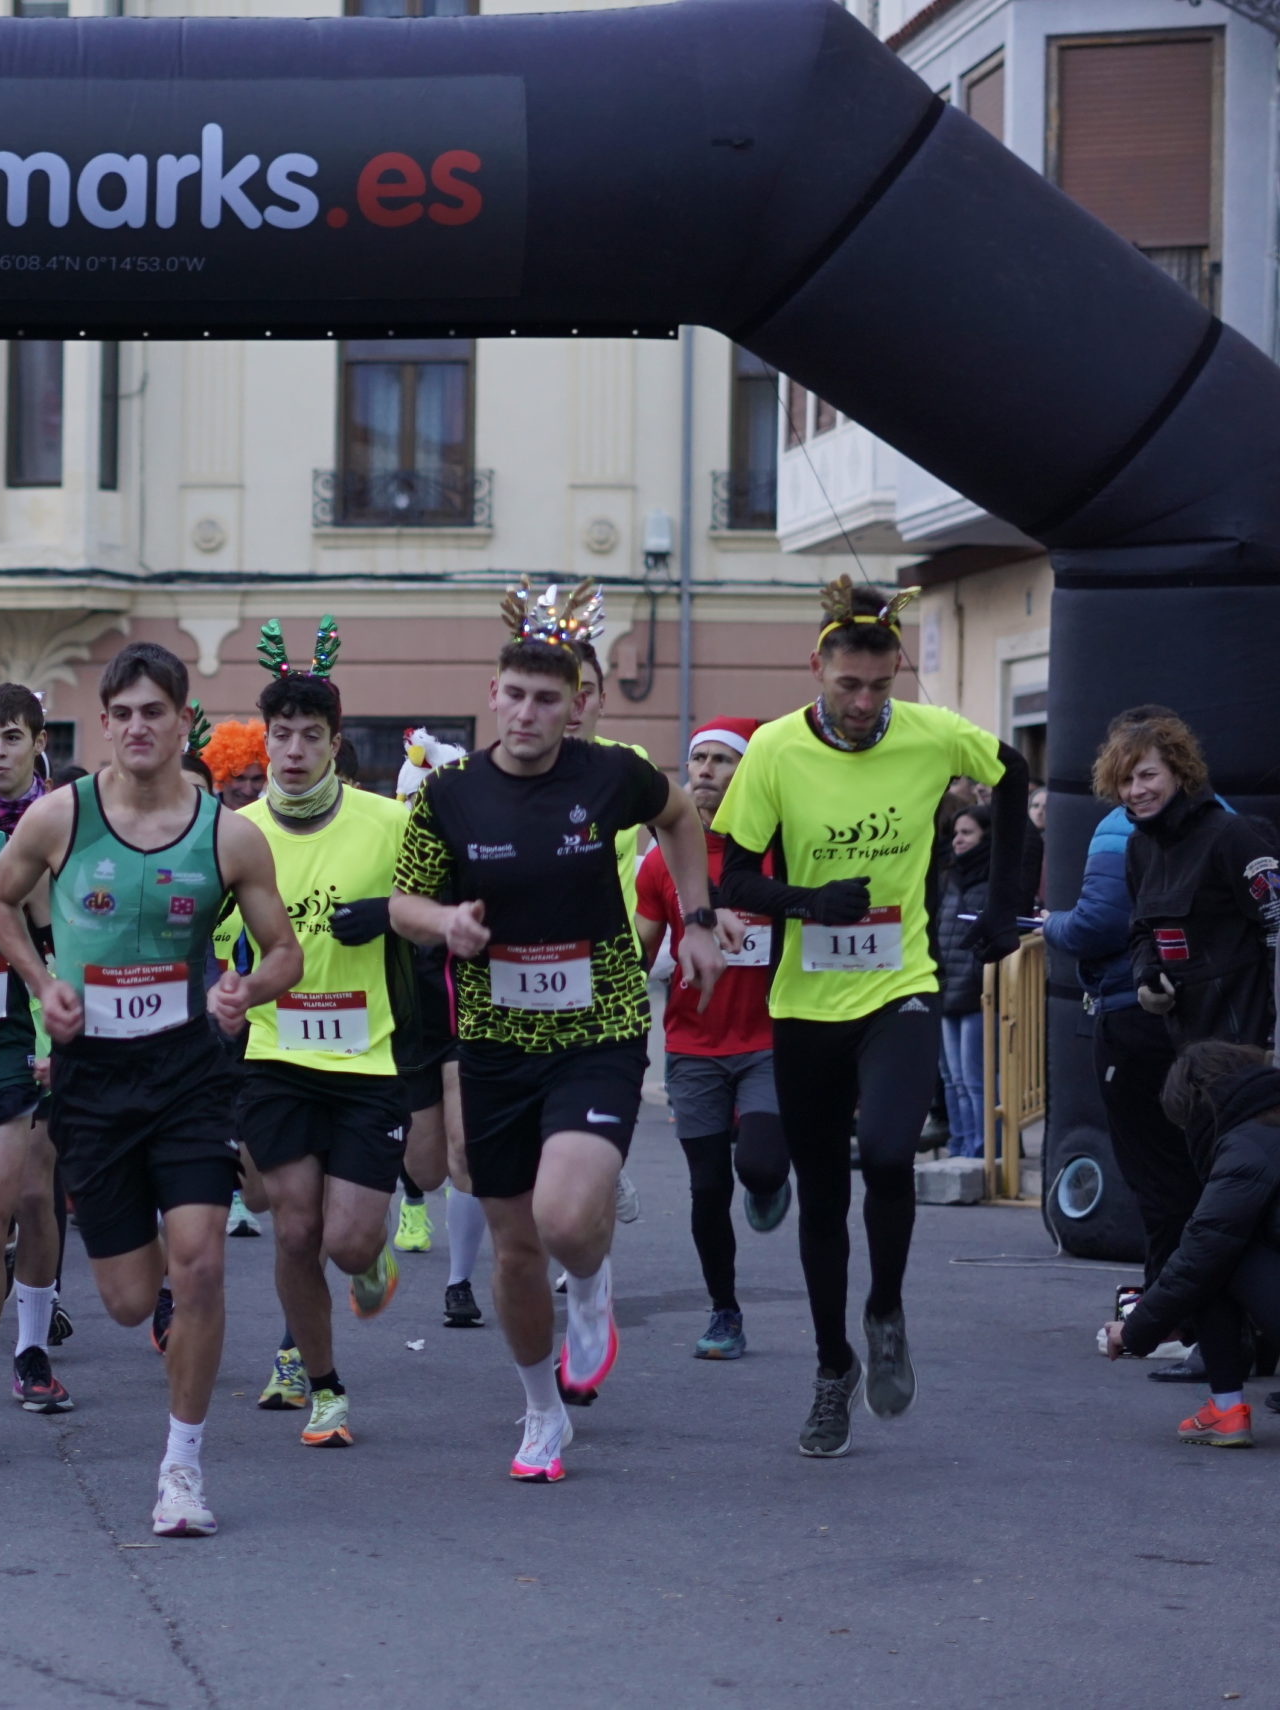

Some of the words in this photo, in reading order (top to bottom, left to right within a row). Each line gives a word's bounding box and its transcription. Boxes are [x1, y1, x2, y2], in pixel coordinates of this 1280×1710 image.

[830, 933, 878, 955] 114
[102, 968, 122, 976] CURSA
[124, 967, 140, 976] SANT
[142, 965, 173, 974] SILVESTRE
[116, 976, 155, 985] VILAFRANCA
[518, 971, 567, 993] 130
[113, 993, 162, 1019] 109
[291, 992, 308, 1000] CURSA
[324, 992, 353, 1000] SILVESTRE
[301, 1018, 344, 1040] 111
